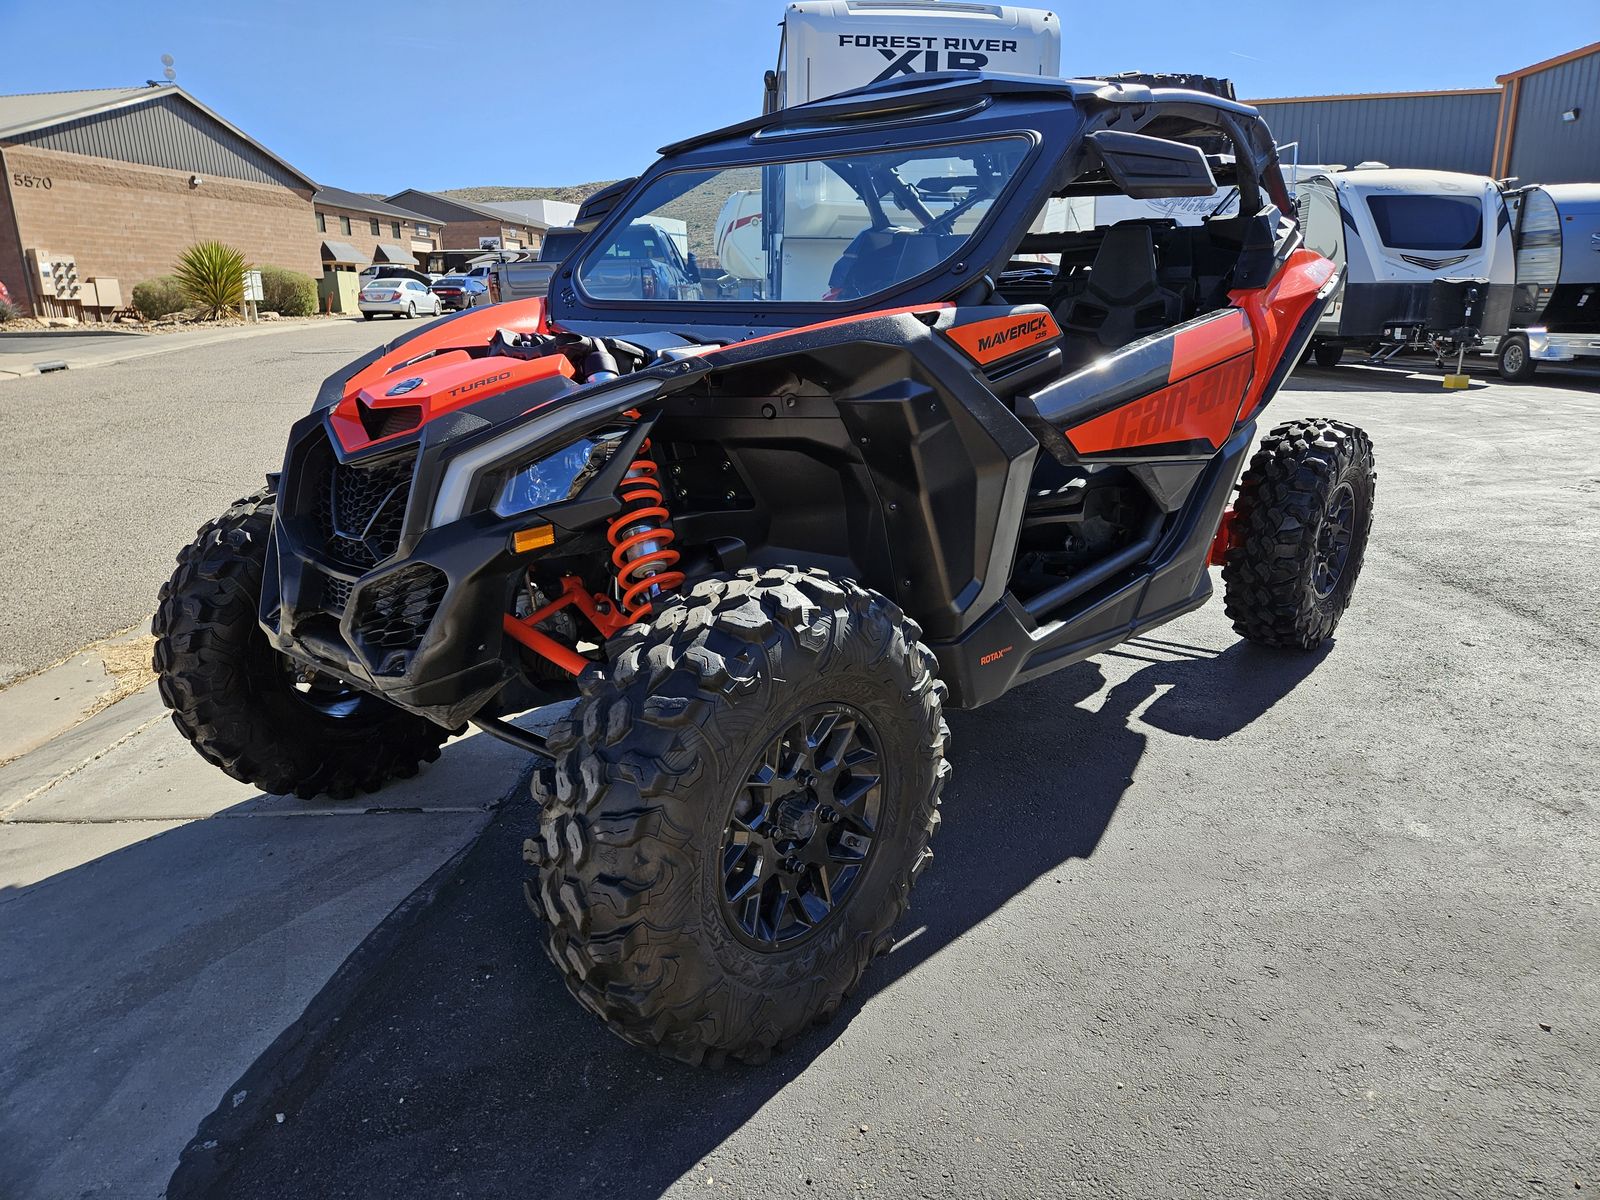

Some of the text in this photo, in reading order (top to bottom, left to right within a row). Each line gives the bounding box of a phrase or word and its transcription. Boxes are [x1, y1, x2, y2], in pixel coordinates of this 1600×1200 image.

[838, 34, 1017, 53] FOREST RIVER
[13, 173, 52, 190] 5570
[978, 315, 1047, 352] MAVERICK
[1034, 330, 1047, 340] DS
[448, 371, 511, 397] TURBO
[980, 650, 1004, 666] ROTAX
